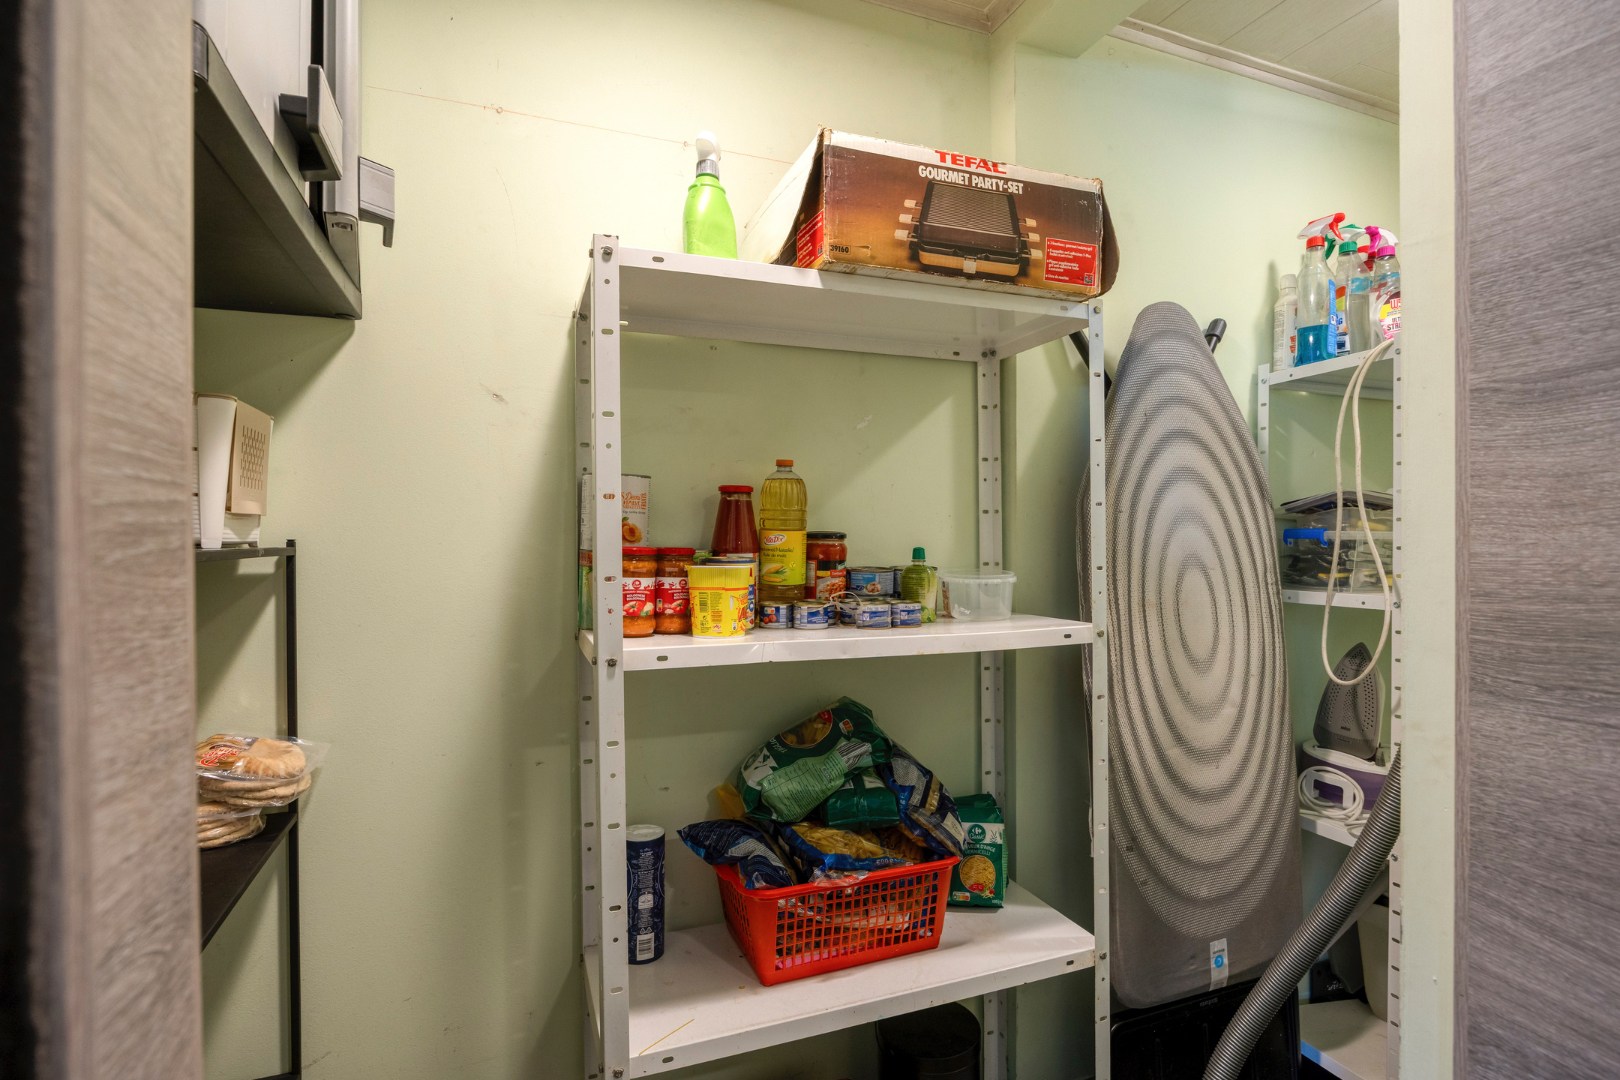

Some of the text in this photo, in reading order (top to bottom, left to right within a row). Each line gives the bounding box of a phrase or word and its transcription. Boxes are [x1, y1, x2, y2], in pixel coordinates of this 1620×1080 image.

[935, 150, 1007, 175] TEFAL
[918, 165, 1024, 195] GOURMET PARTY-SET
